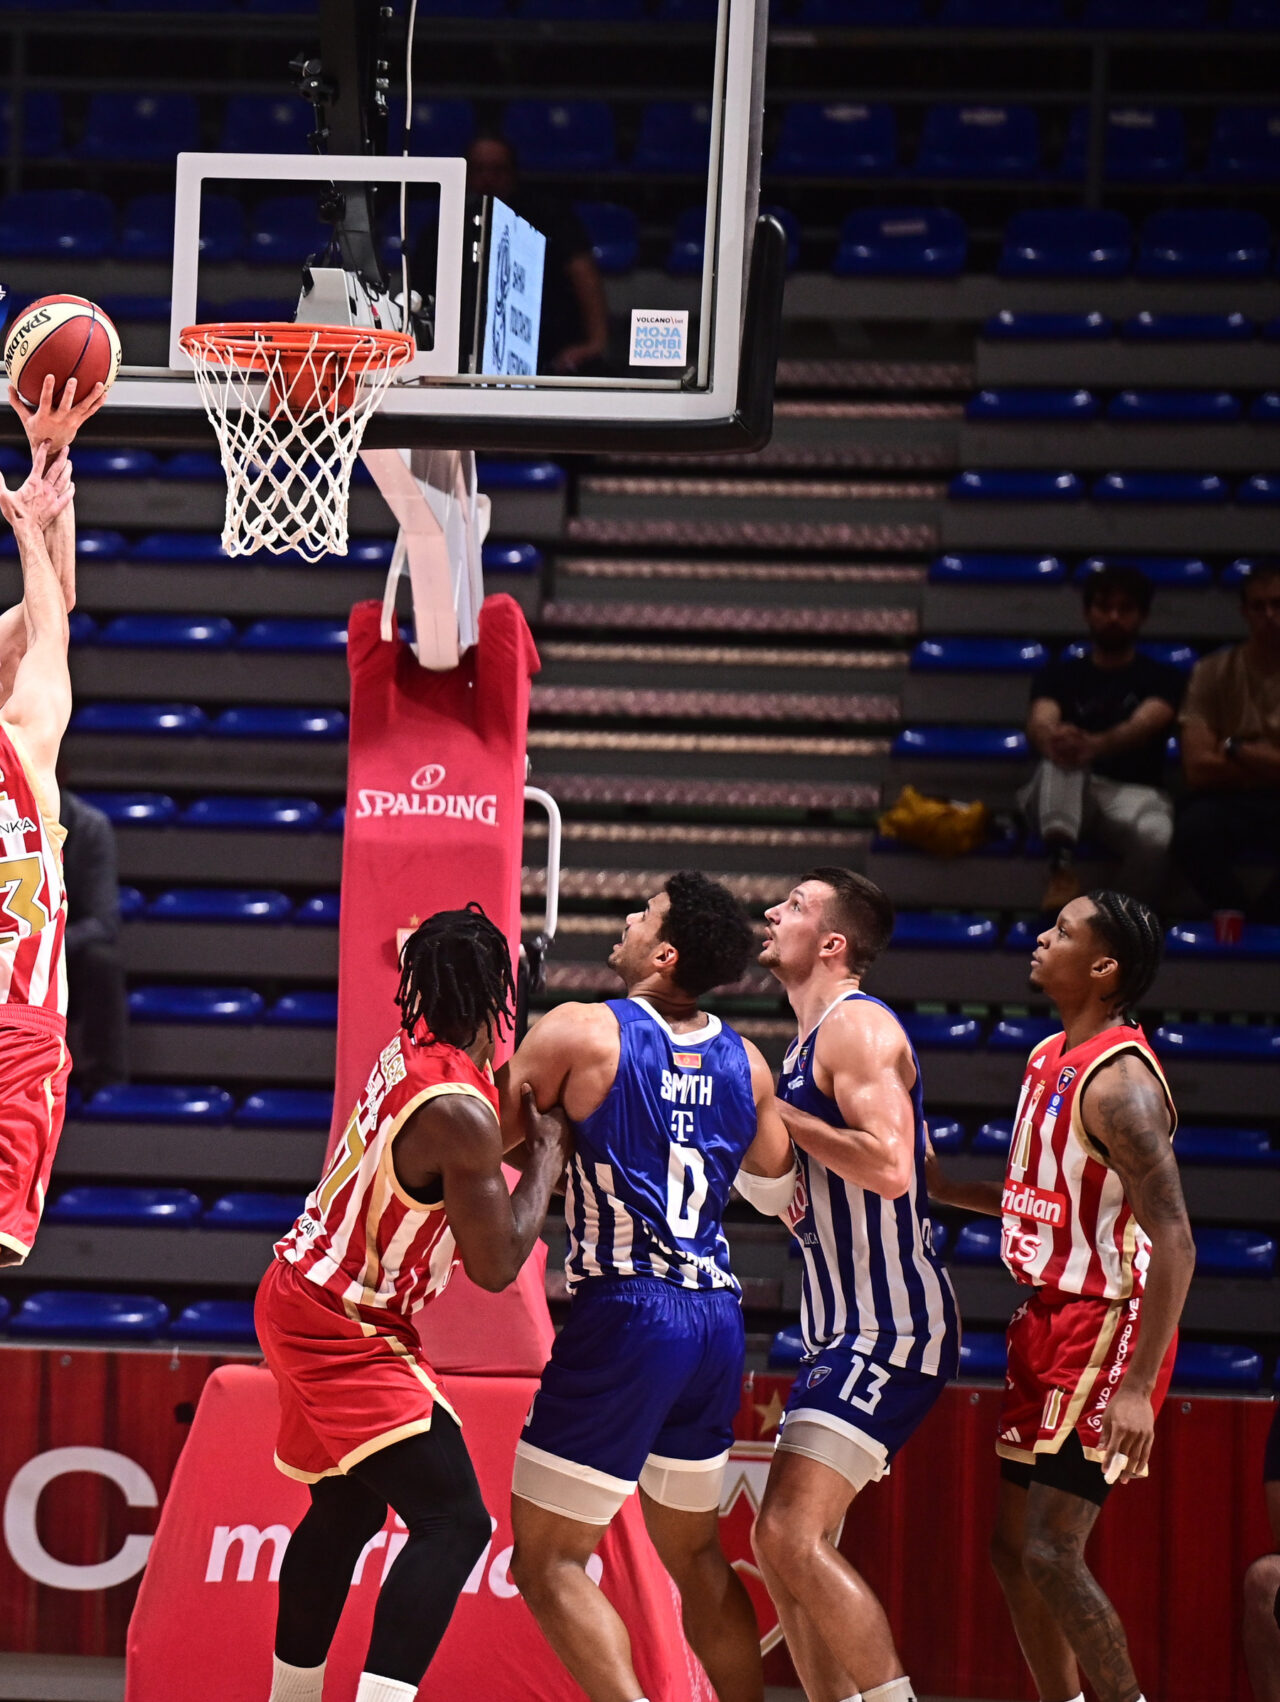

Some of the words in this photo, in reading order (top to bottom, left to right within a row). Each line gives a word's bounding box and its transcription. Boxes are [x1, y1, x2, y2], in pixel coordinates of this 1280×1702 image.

[635, 338, 682, 350] KOMBI
[636, 327, 681, 338] MOJA
[634, 350, 682, 360] NACIJA
[355, 789, 497, 827] SPALDING
[1001, 1225, 1041, 1263] ts
[1108, 1324, 1133, 1385] CONCORD
[838, 1354, 892, 1416] 13
